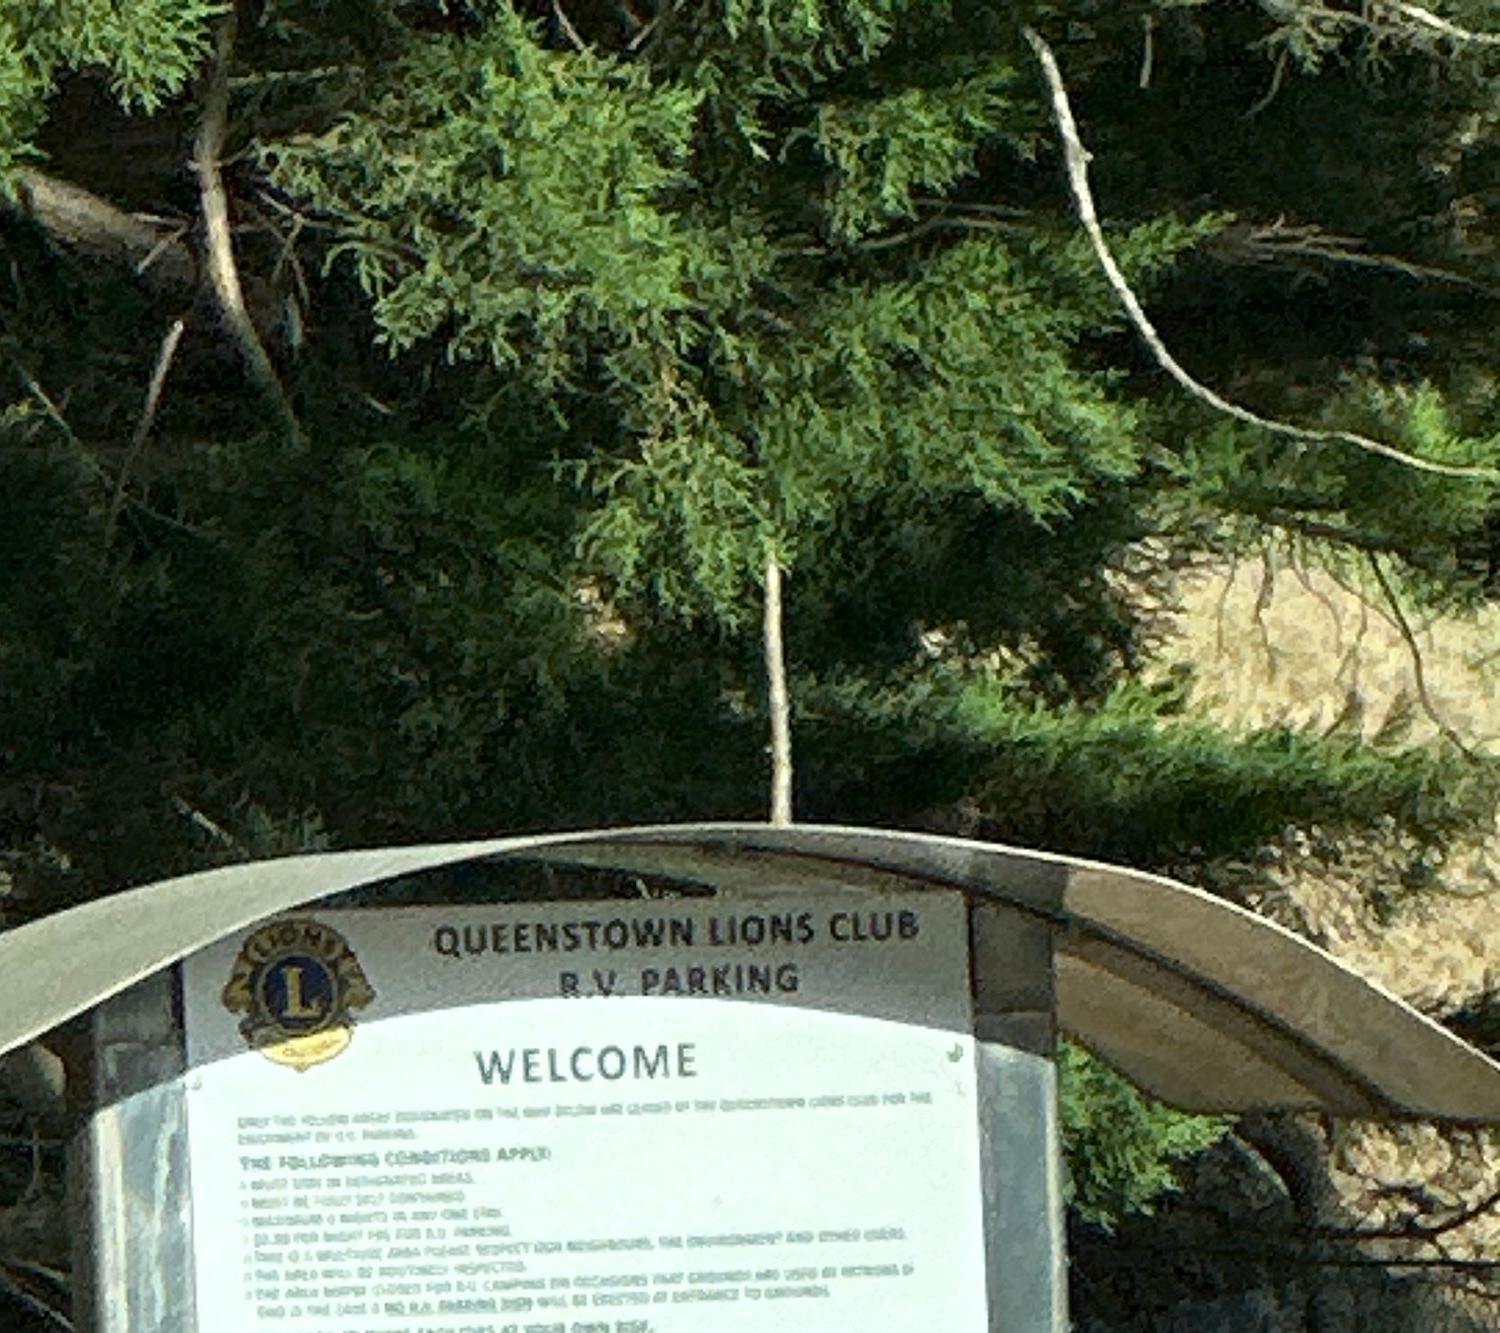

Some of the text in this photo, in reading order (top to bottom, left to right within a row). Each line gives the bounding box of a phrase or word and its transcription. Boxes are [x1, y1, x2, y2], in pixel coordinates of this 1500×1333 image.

[433, 910, 920, 959] QUEENSTOWN LIONS CLUB
[280, 965, 323, 1018] L
[641, 962, 799, 998] PARKING
[474, 1042, 698, 1086] WELCOME
